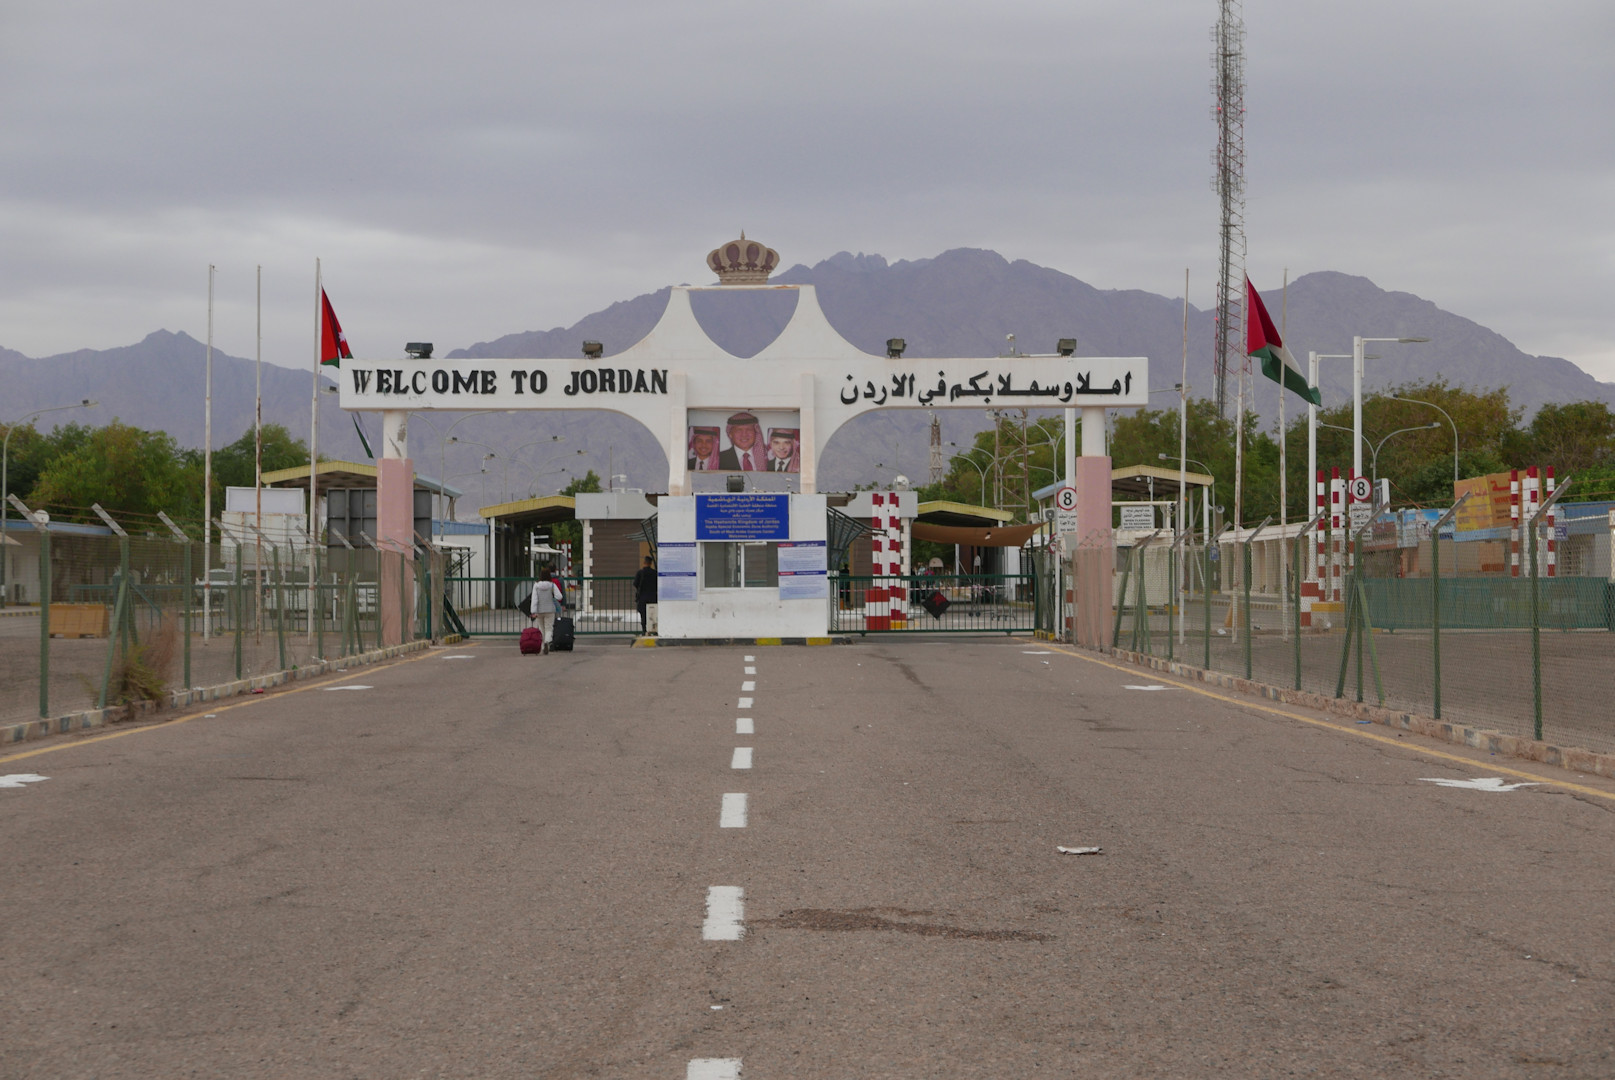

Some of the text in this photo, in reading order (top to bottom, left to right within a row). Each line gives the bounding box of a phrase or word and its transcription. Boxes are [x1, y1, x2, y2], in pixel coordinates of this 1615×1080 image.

[352, 368, 668, 396] WELCOME TO JORDAN
[840, 370, 1132, 407] اهلا وسهلا بكم في الاردن
[1063, 492, 1072, 506] 8
[1357, 481, 1366, 496] 8
